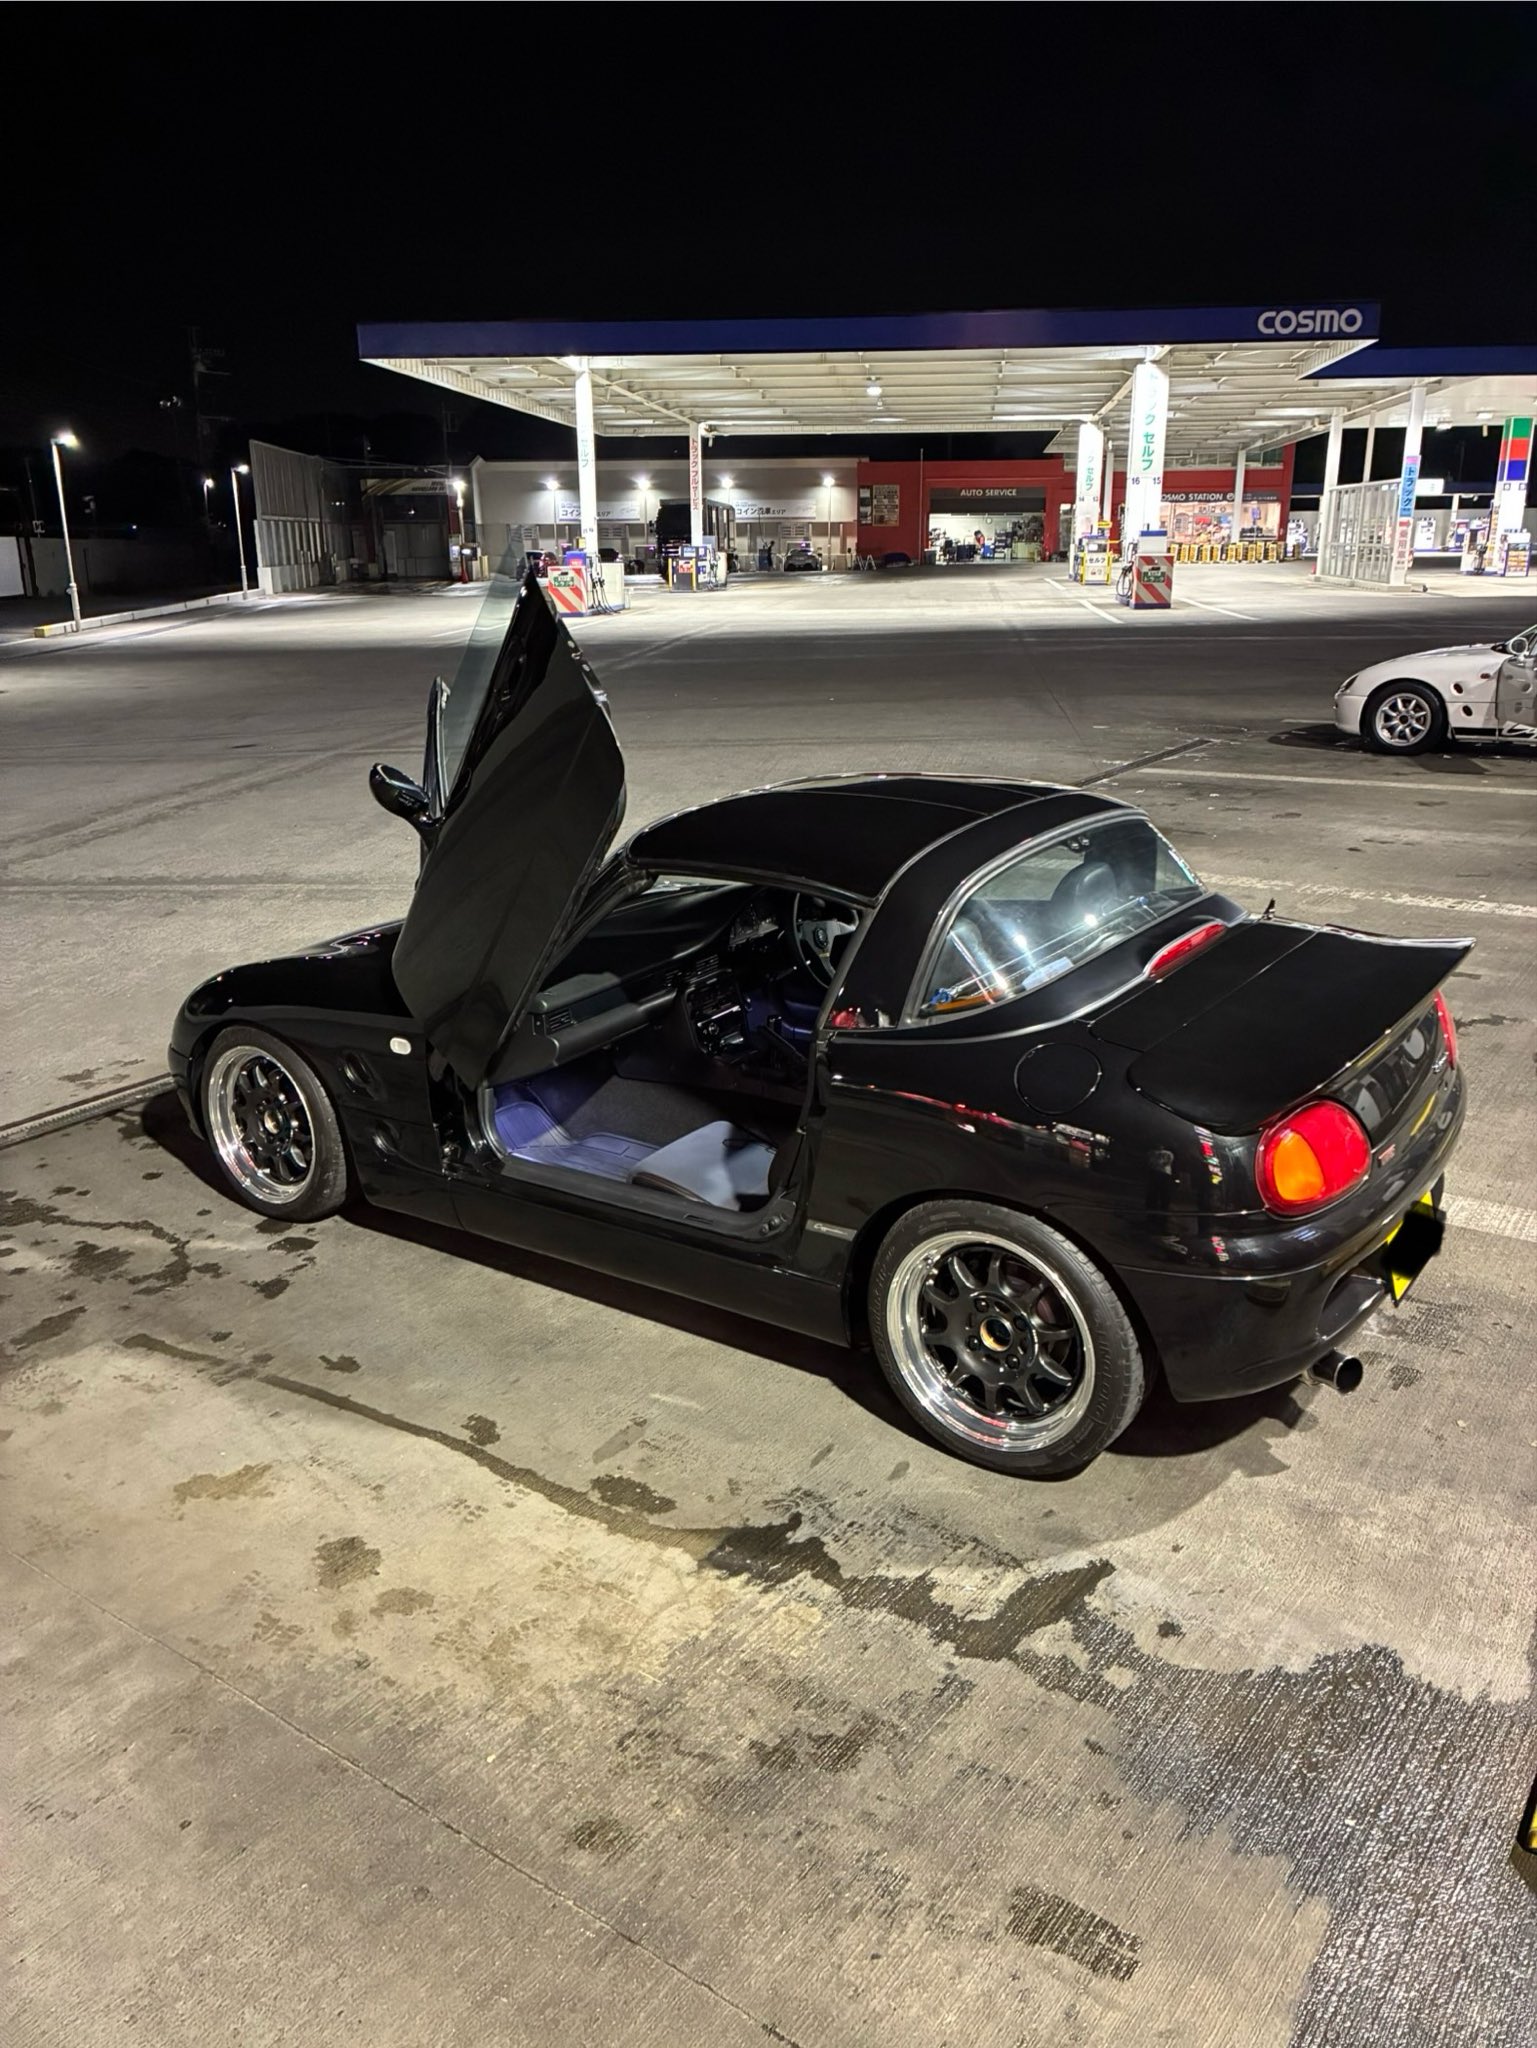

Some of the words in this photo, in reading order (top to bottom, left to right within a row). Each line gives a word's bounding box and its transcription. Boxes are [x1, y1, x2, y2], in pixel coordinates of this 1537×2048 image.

[1258, 308, 1362, 334] COSMO
[1142, 432, 1155, 471] セルフ
[1132, 477, 1140, 485] 16
[1153, 477, 1161, 485] 15
[1403, 467, 1415, 507] トラック
[1161, 493, 1186, 501] OSMO
[1188, 493, 1223, 501] STATION
